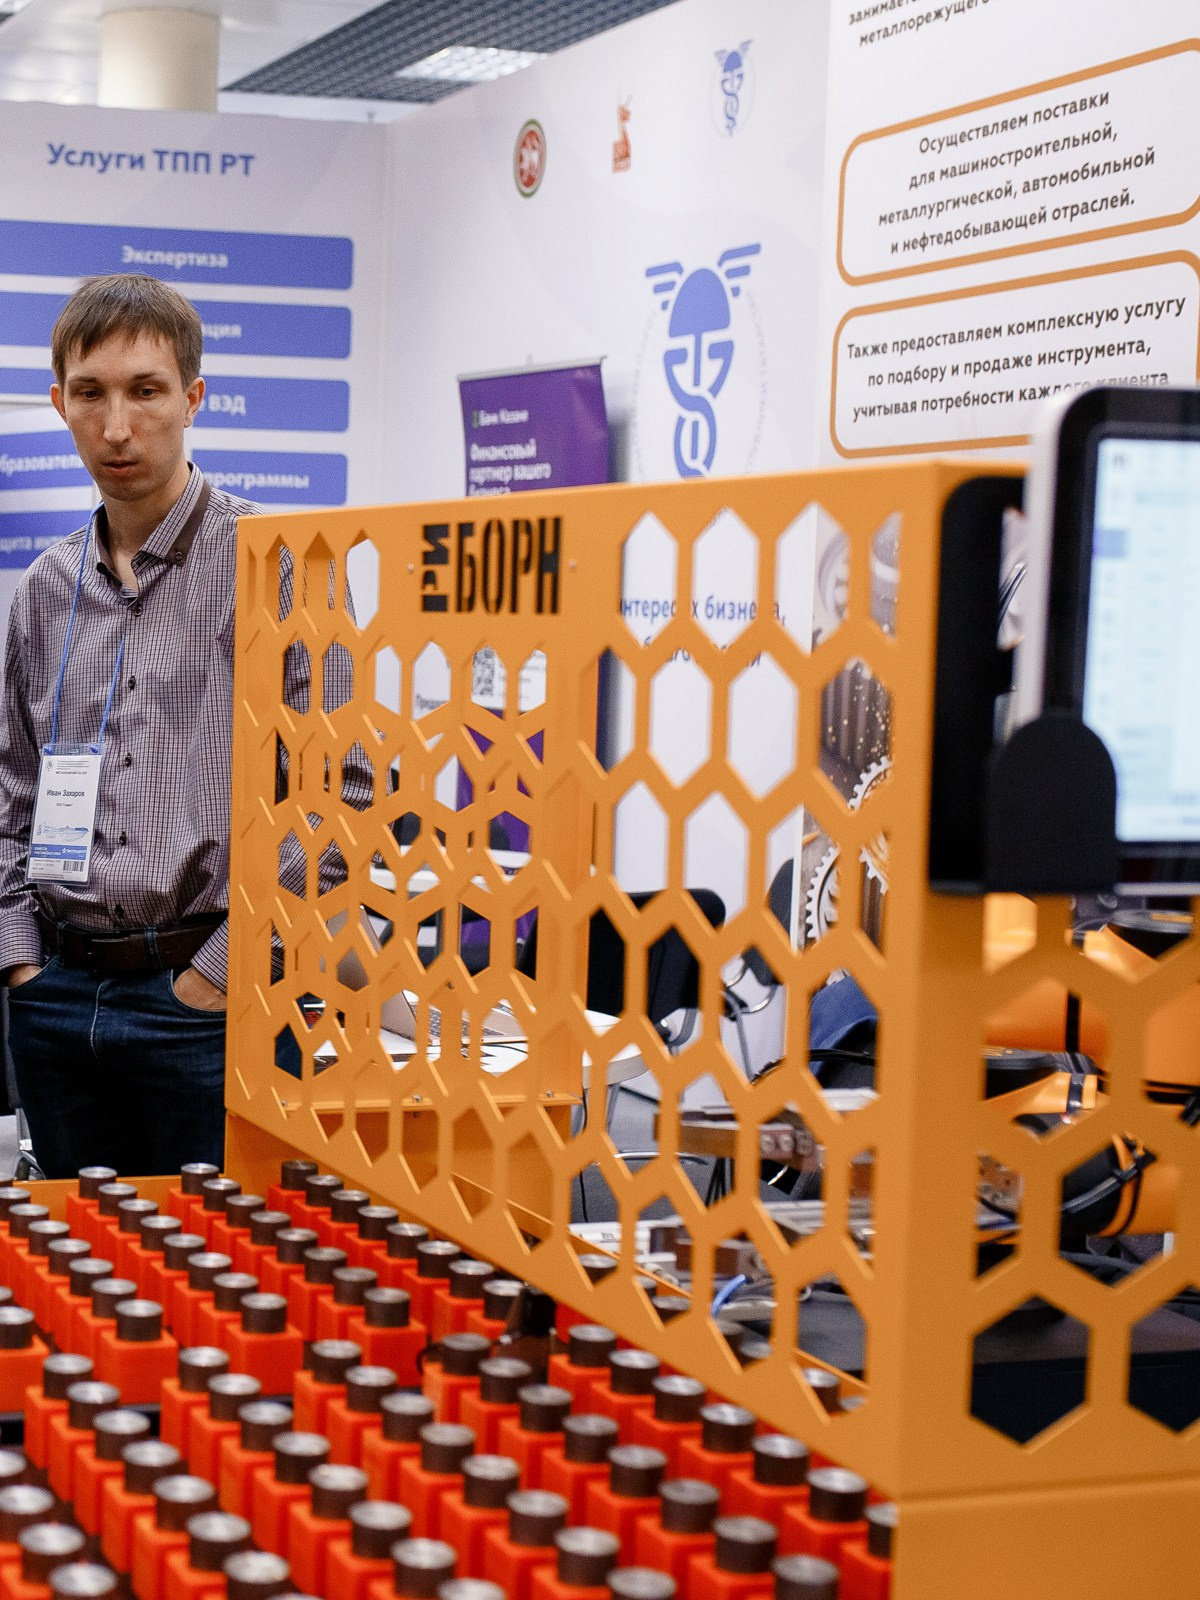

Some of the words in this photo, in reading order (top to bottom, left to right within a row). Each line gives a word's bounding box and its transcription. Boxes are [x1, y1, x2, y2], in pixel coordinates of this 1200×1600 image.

[849, 0, 919, 25] занимае
[919, 113, 1028, 154] Осуществляем
[1033, 91, 1110, 125] поставки
[46, 143, 146, 174] Услуги
[153, 150, 212, 174] ТПП
[220, 154, 256, 176] РТ
[909, 173, 935, 191] для
[940, 122, 1118, 180] машиностроительной,
[879, 180, 1018, 226] металлургической,
[1022, 147, 1156, 194] автомобильной
[890, 241, 899, 254] и
[902, 208, 1048, 252] нефтедобывающей
[1051, 190, 1135, 221] отраслей.
[121, 244, 229, 269] Экспертиза
[847, 340, 888, 359] Также
[892, 325, 1003, 355] предоставляем
[1007, 308, 1119, 337] комплексную
[1124, 297, 1186, 323] услугу
[868, 373, 884, 388] по
[887, 362, 948, 387] подбору
[951, 364, 960, 377] и
[964, 352, 1034, 377] продаже
[1037, 339, 1152, 371] инструмента,
[853, 401, 918, 423] учитывая
[921, 385, 1014, 413] потребности
